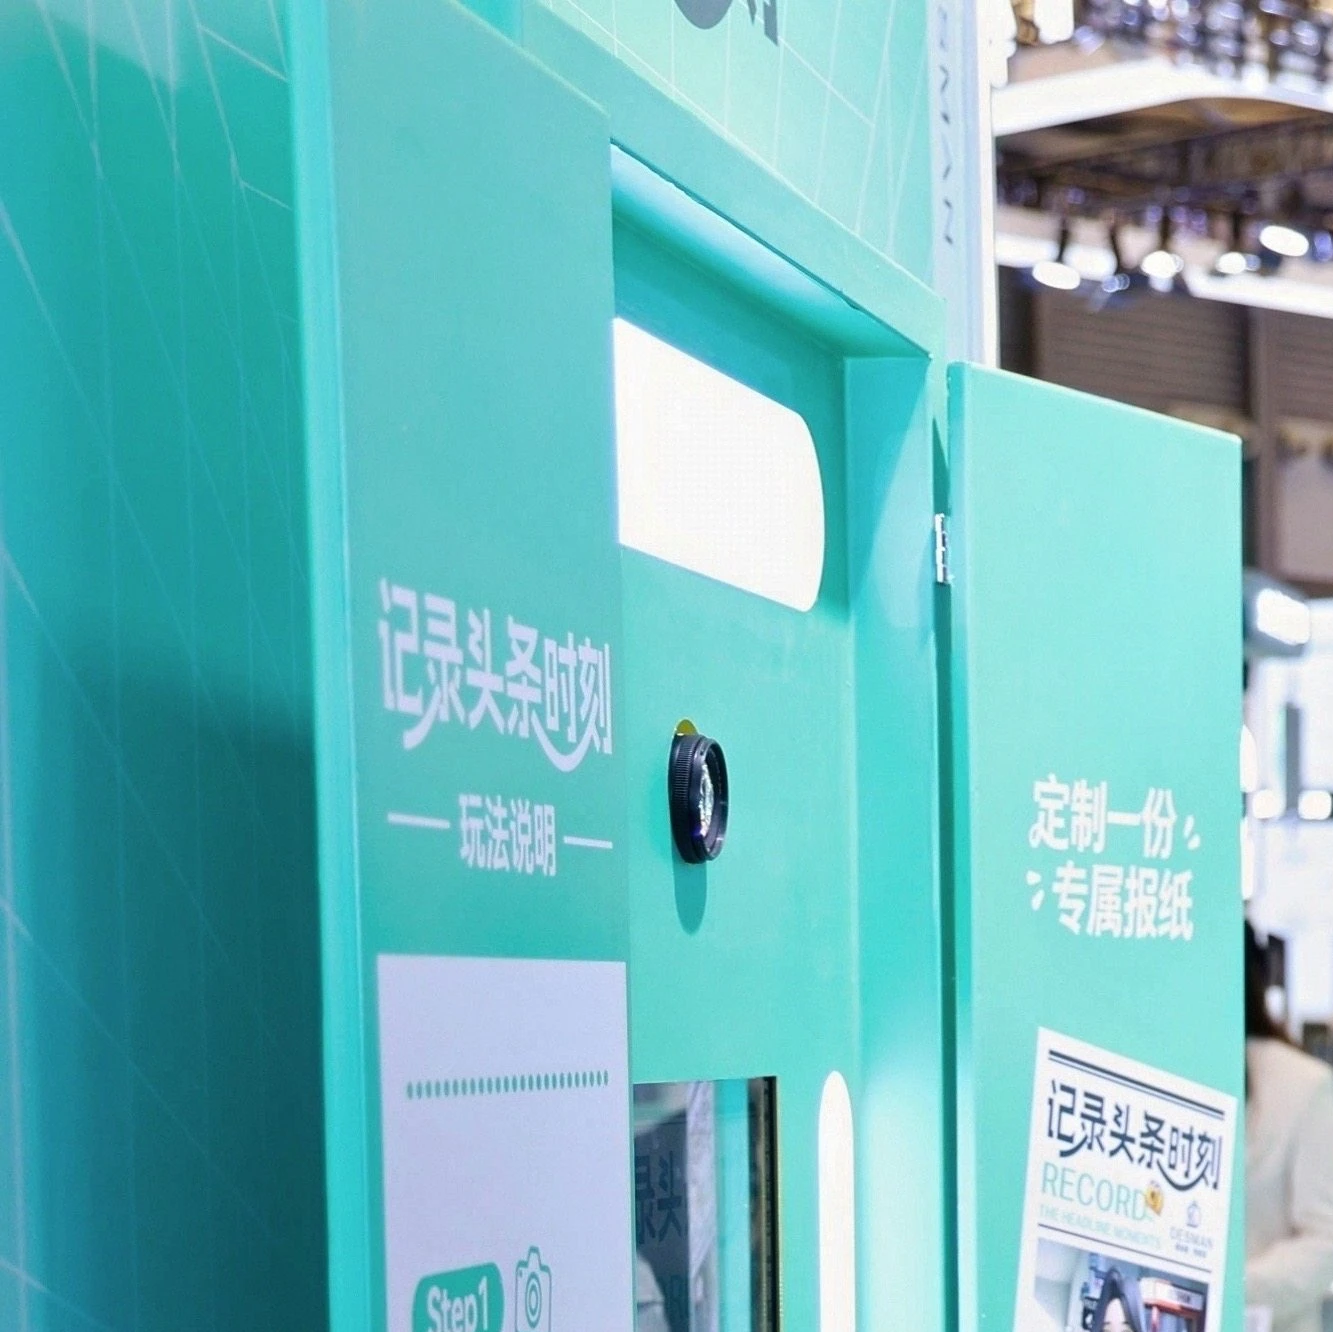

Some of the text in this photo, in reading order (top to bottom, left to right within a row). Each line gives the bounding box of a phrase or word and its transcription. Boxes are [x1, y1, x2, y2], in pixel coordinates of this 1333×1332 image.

[378, 577, 613, 772] 记录头条时刻
[458, 793, 556, 877] 玩法说明
[1028, 772, 1177, 860] 定制一份
[1051, 860, 1194, 942] 专属报纸
[1047, 1079, 1223, 1191] 记录头条时刻
